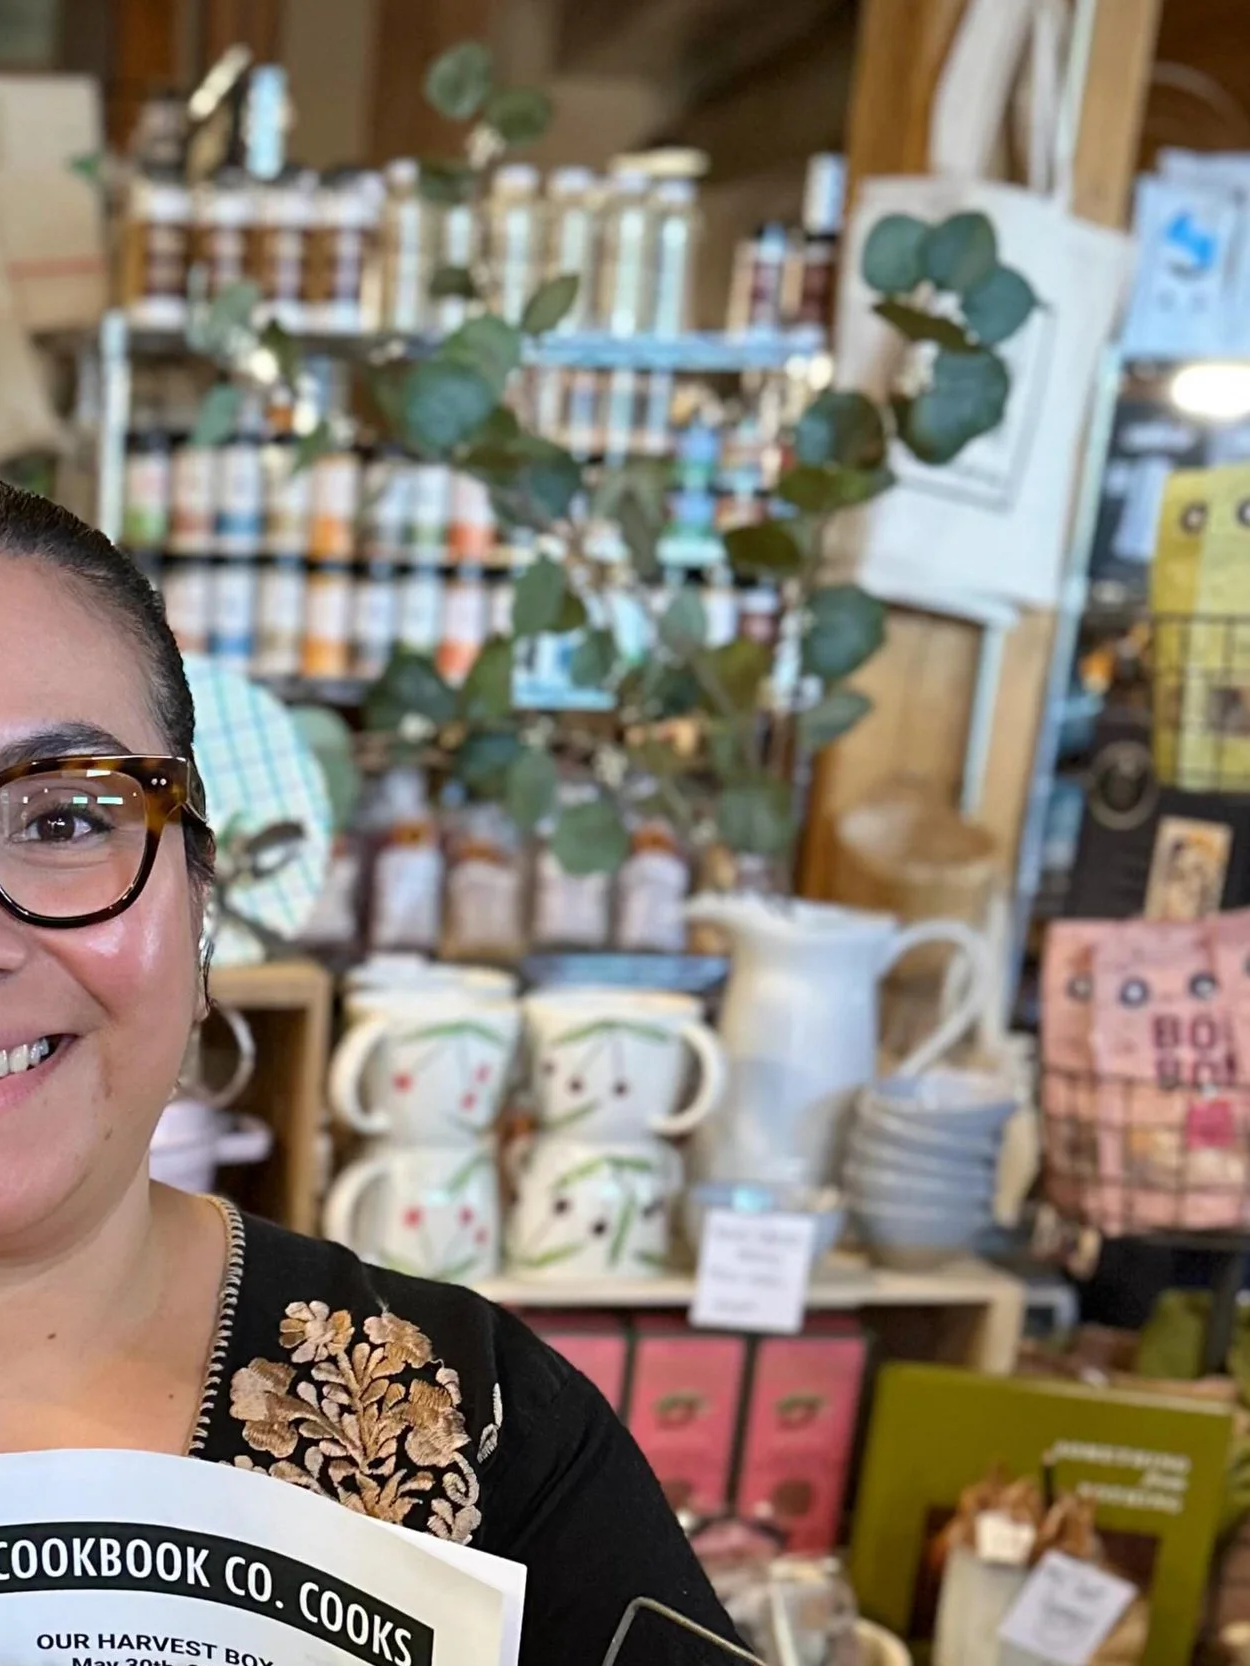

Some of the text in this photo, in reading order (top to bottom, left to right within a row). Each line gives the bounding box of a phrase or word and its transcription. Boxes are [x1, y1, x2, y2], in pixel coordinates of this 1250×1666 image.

[224, 1555, 284, 1610] CO.
[36, 1633, 91, 1650] OUR
[98, 1633, 218, 1660] HARVEST
